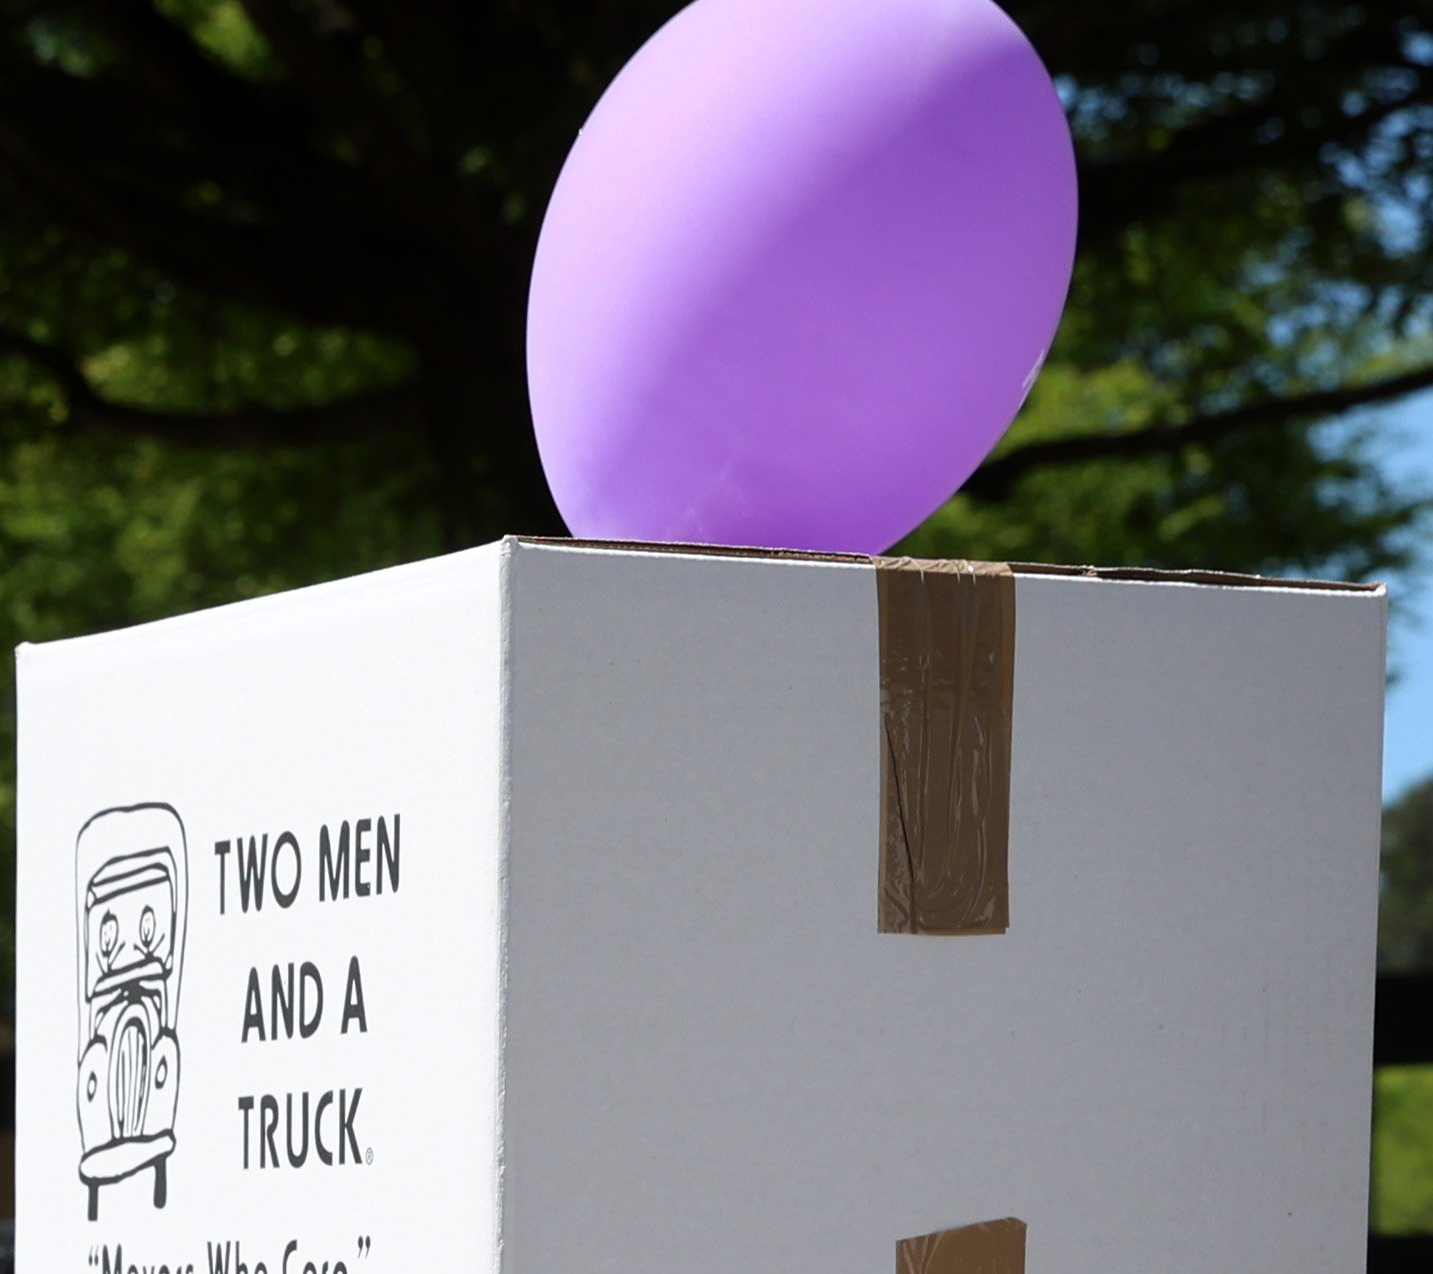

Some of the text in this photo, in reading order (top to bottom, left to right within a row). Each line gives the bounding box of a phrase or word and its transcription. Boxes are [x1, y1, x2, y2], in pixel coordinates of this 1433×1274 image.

[214, 813, 400, 915] TWO MEN
[241, 956, 367, 1043] AND A
